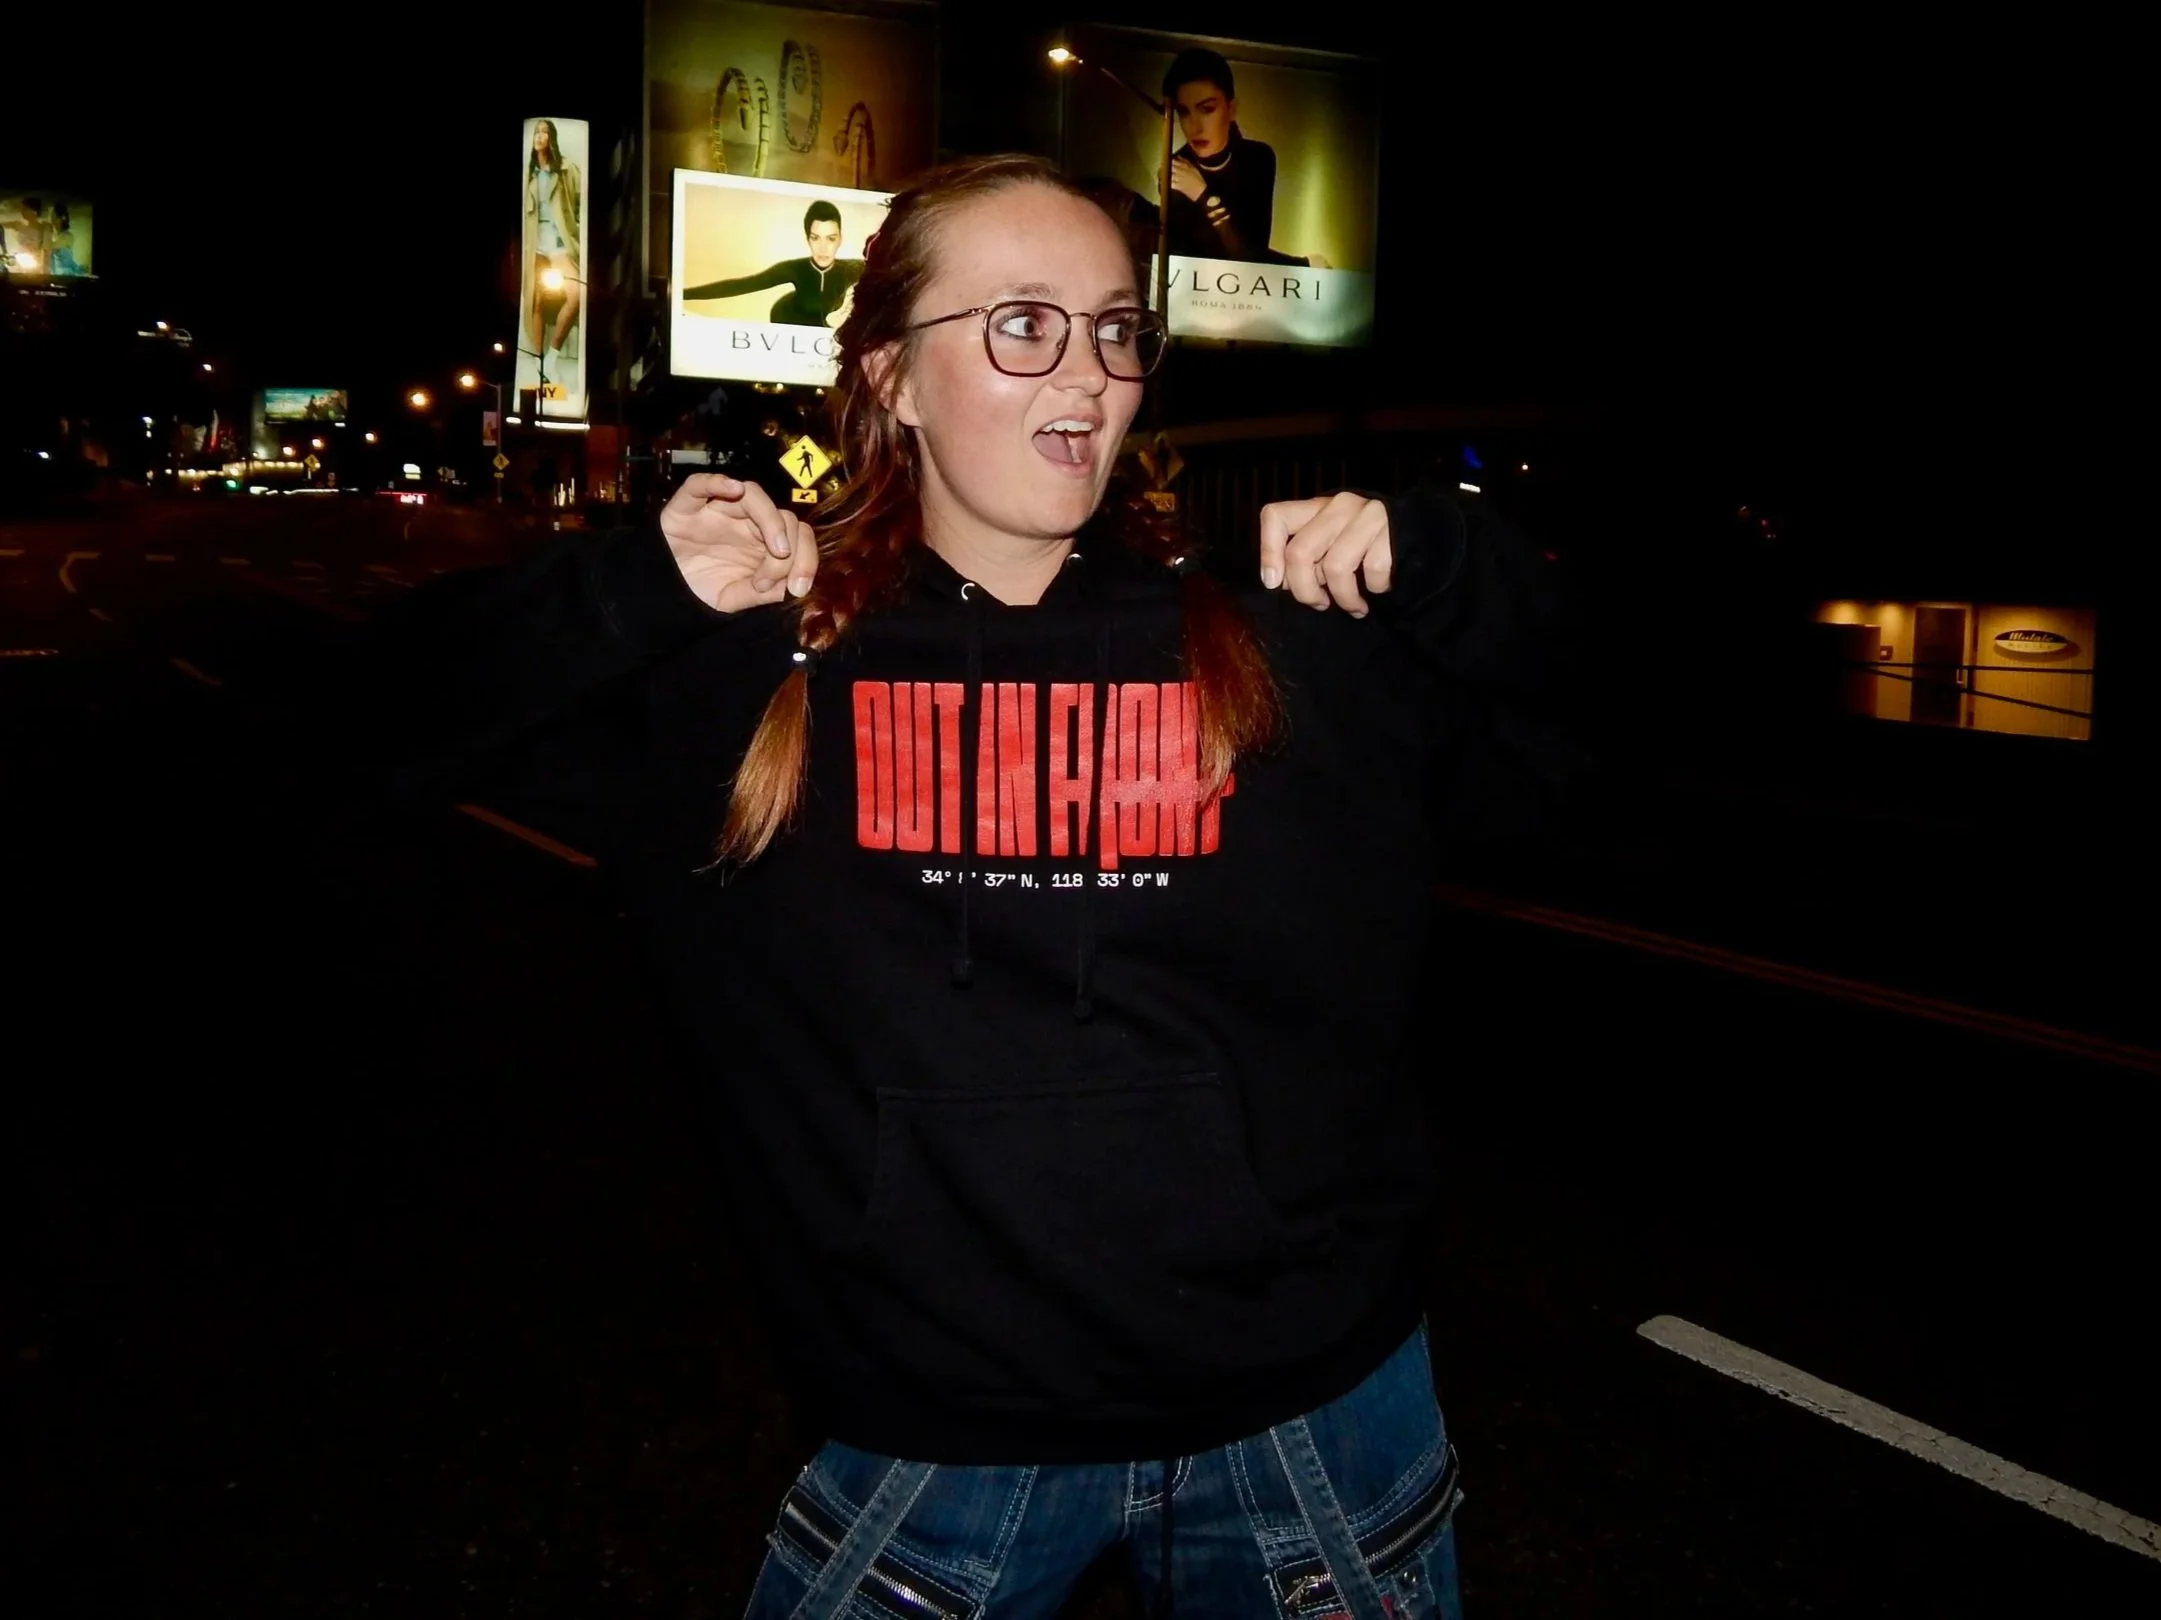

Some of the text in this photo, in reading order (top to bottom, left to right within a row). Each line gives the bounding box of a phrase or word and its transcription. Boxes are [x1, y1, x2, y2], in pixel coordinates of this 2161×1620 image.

[1168, 269, 1320, 300] VLGARI
[731, 330, 835, 357] BVLG
[853, 681, 965, 854] OUT
[976, 682, 1037, 856] IN
[1156, 872, 1169, 887] W
